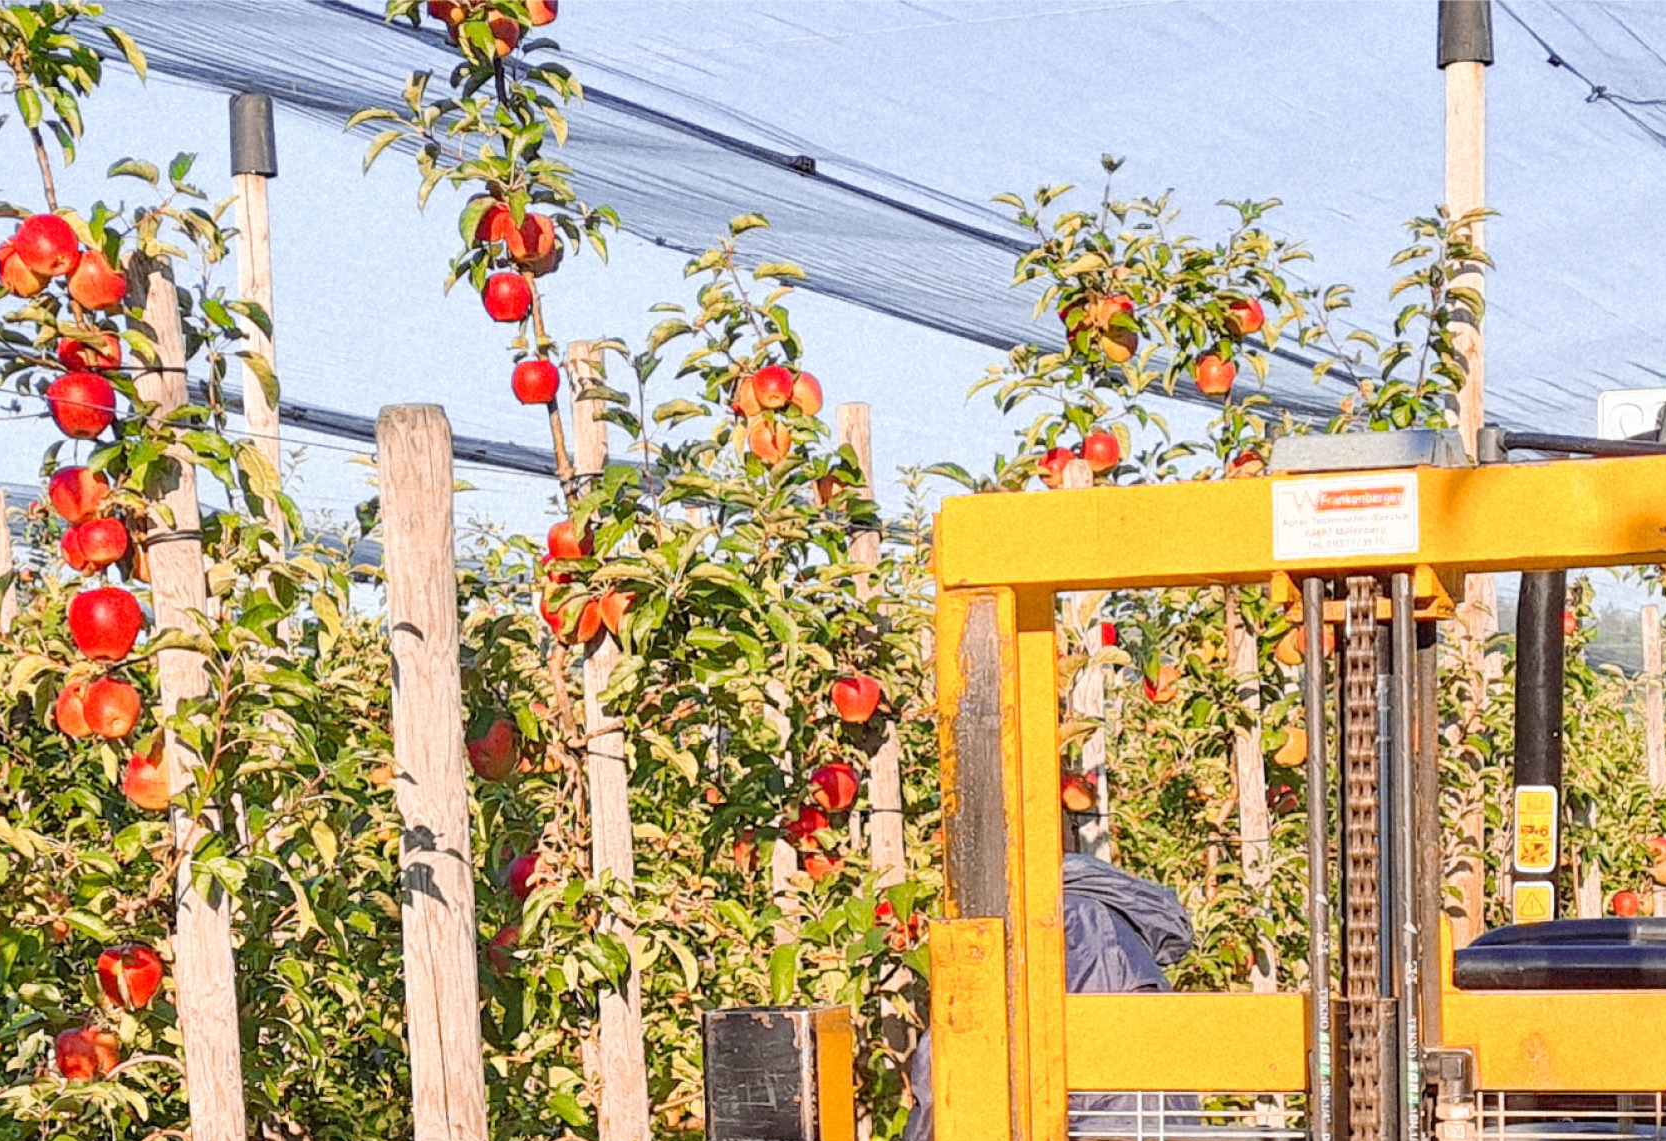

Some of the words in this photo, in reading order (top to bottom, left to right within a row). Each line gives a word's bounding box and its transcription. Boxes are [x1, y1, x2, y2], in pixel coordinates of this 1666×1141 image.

[1320, 492, 1403, 507] Frankenberger
[1319, 987, 1330, 1030] TEKNO
[1407, 1016, 1418, 1059] TEKNO
